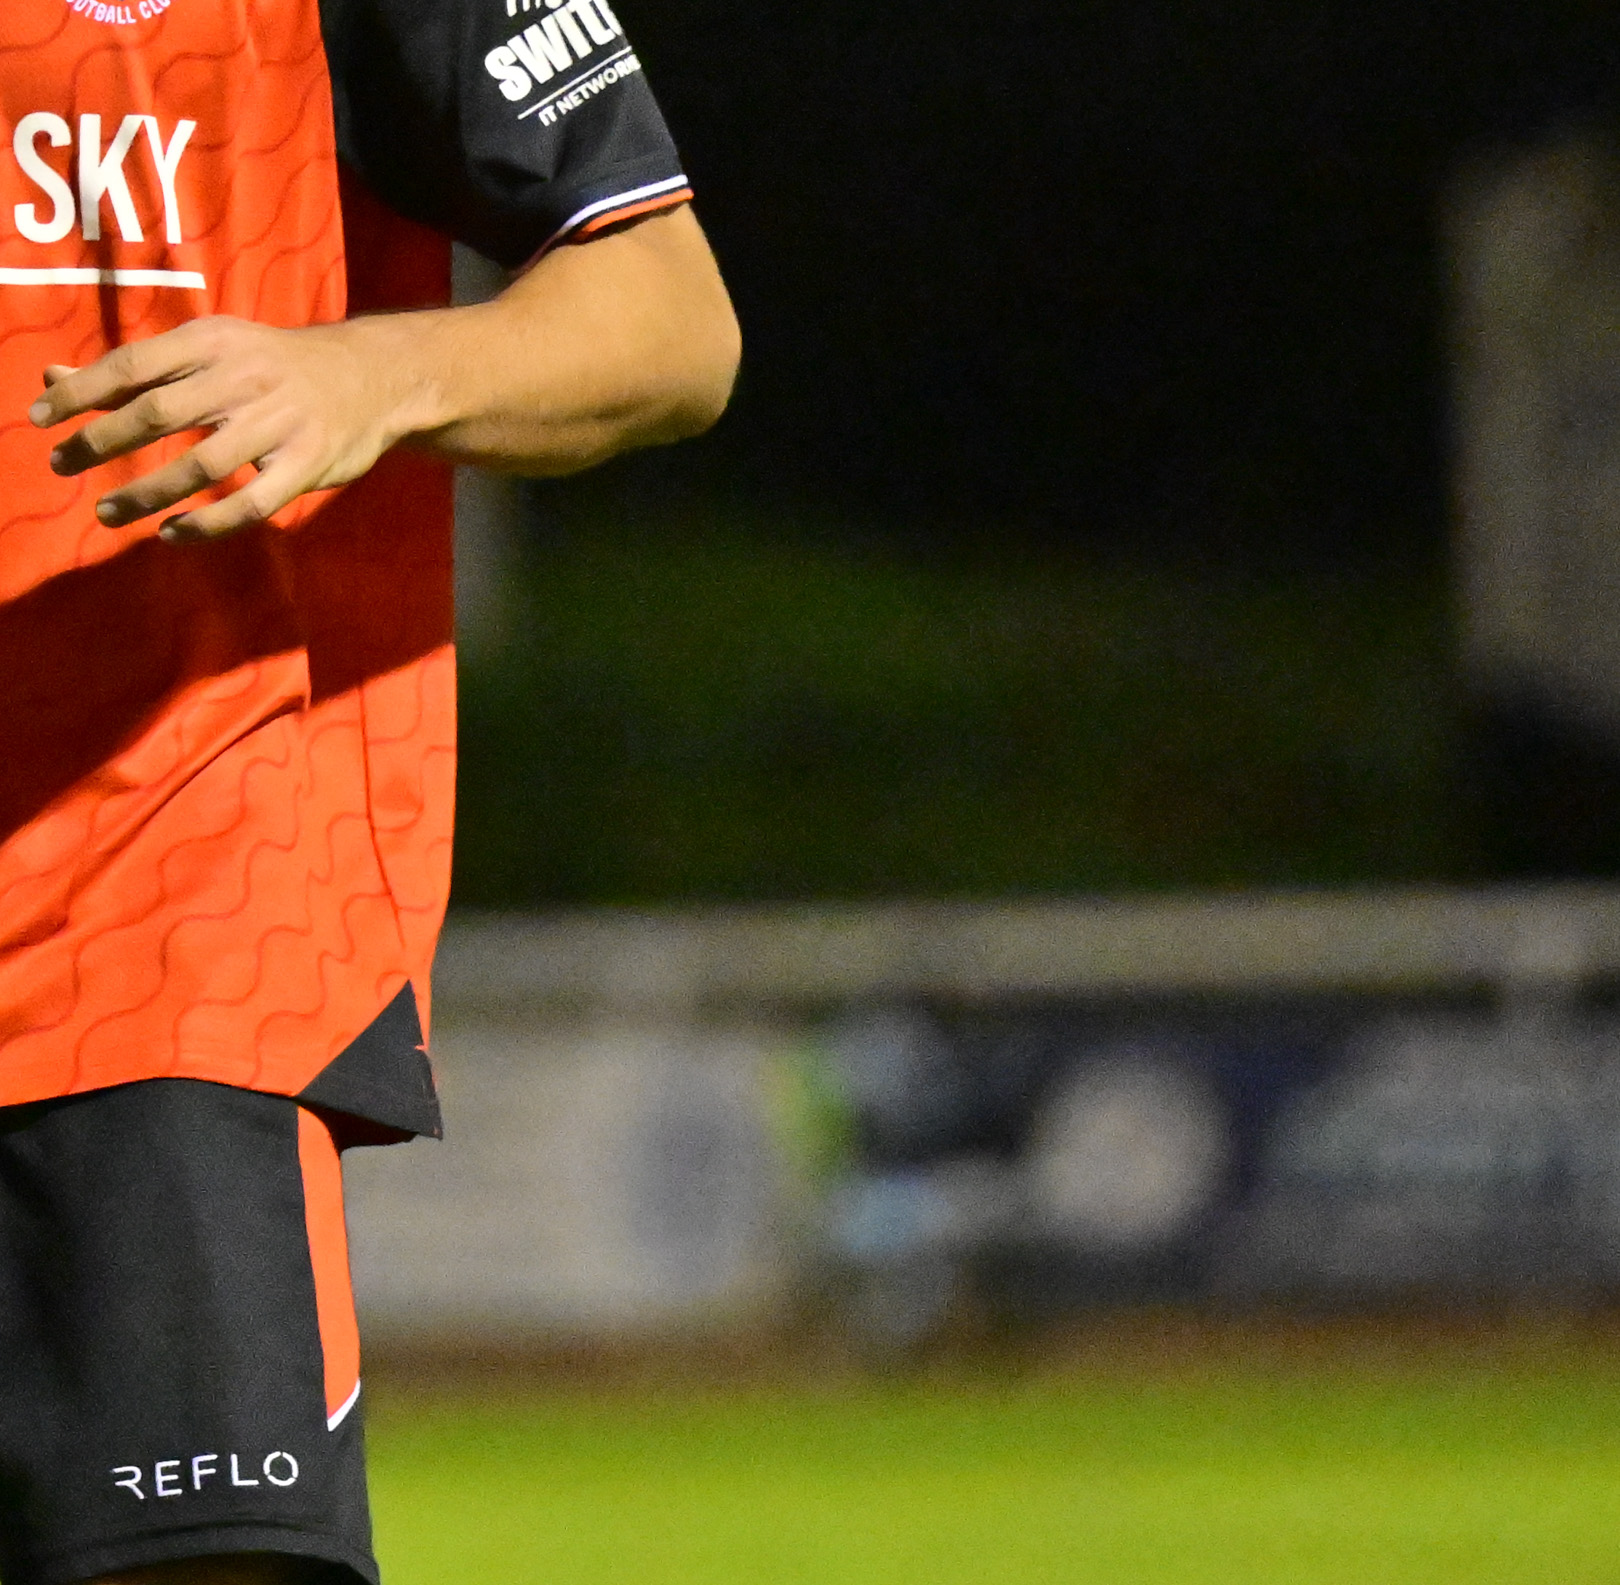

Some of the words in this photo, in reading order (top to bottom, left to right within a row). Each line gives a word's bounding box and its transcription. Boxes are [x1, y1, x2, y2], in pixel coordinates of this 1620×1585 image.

[538, 105, 558, 127] IT
[13, 112, 197, 245] SKY
[112, 1450, 300, 1500] REFLO
